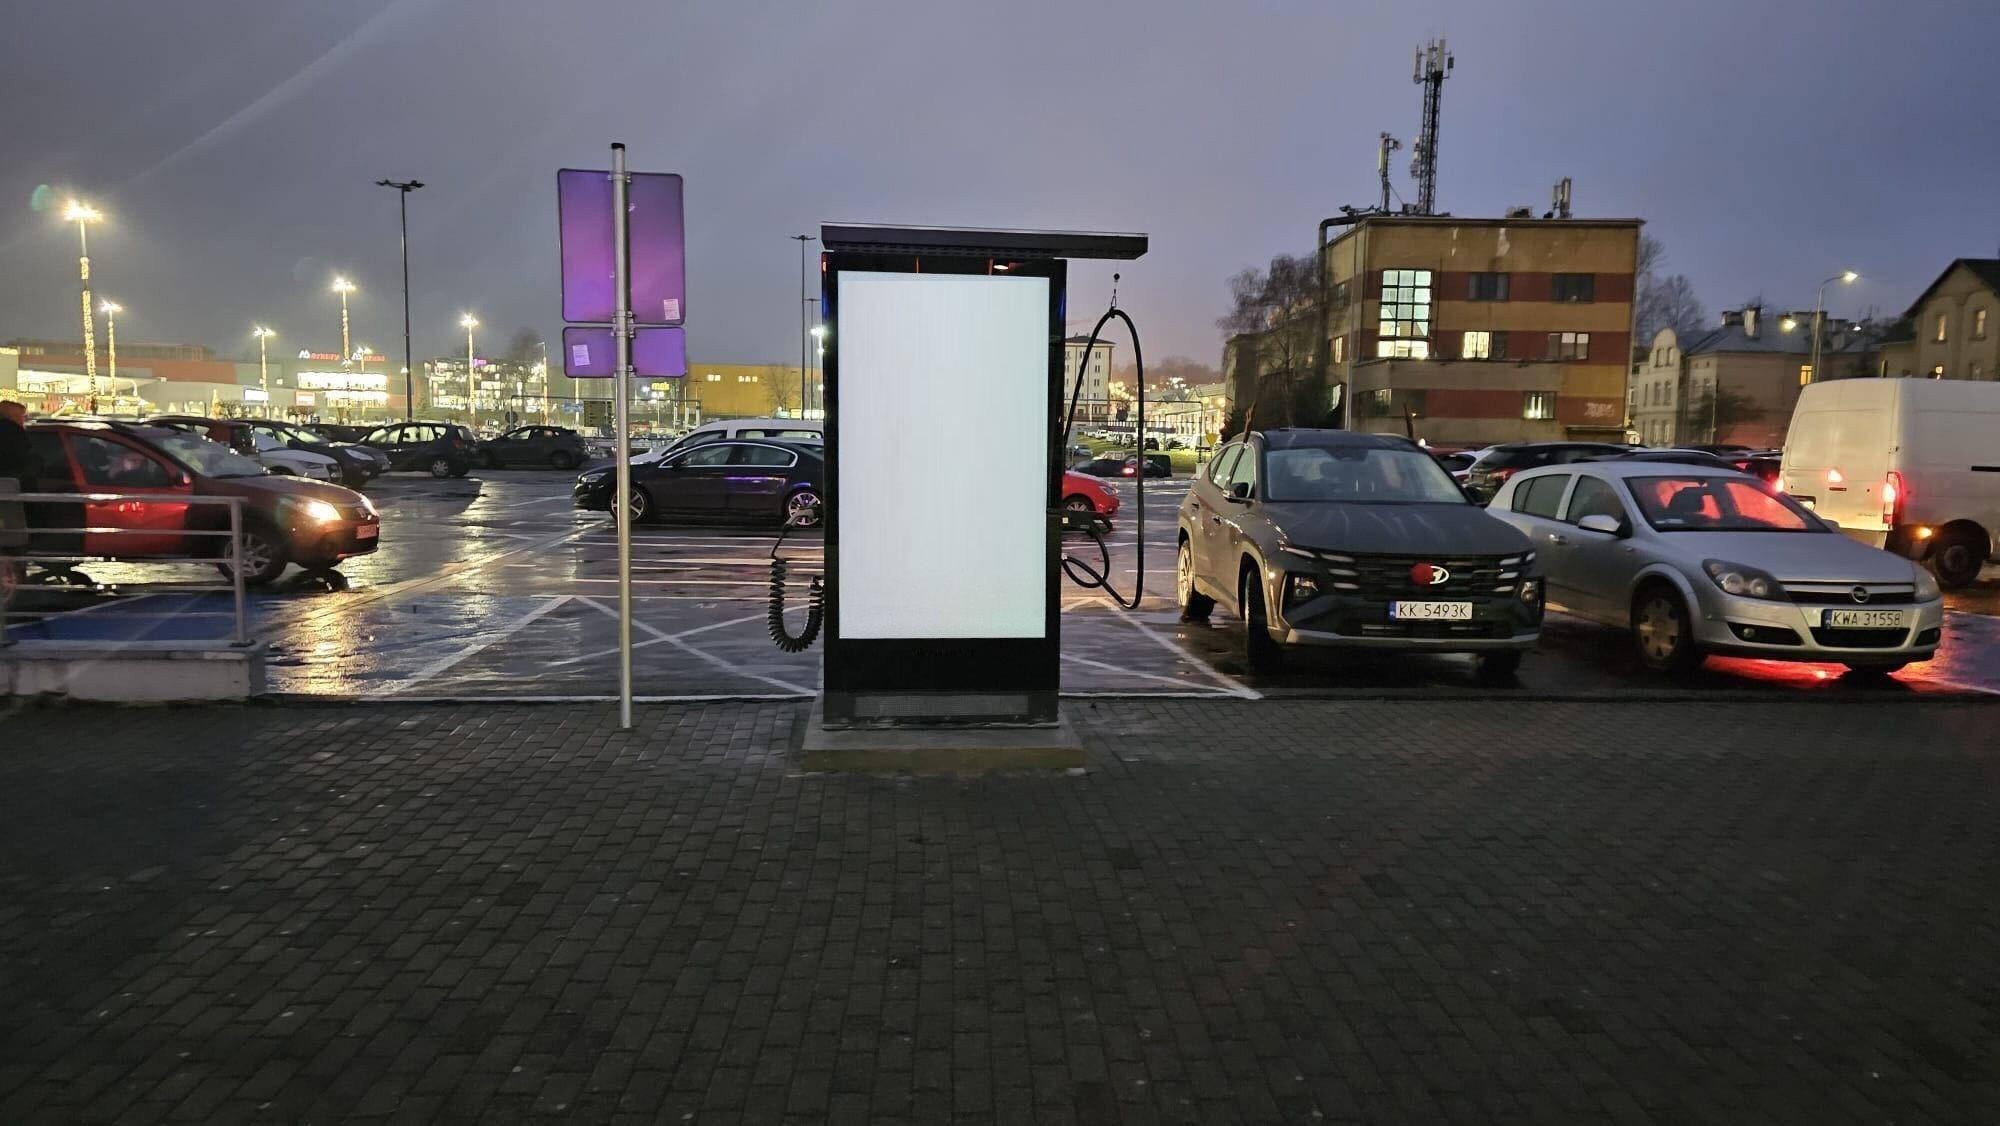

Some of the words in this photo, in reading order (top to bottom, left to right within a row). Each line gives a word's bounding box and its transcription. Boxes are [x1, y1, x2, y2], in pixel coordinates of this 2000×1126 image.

[1399, 603, 1417, 617] KK
[1424, 603, 1468, 618] 5493K
[1833, 611, 1858, 625] KWA
[1863, 612, 1902, 626] 31558
